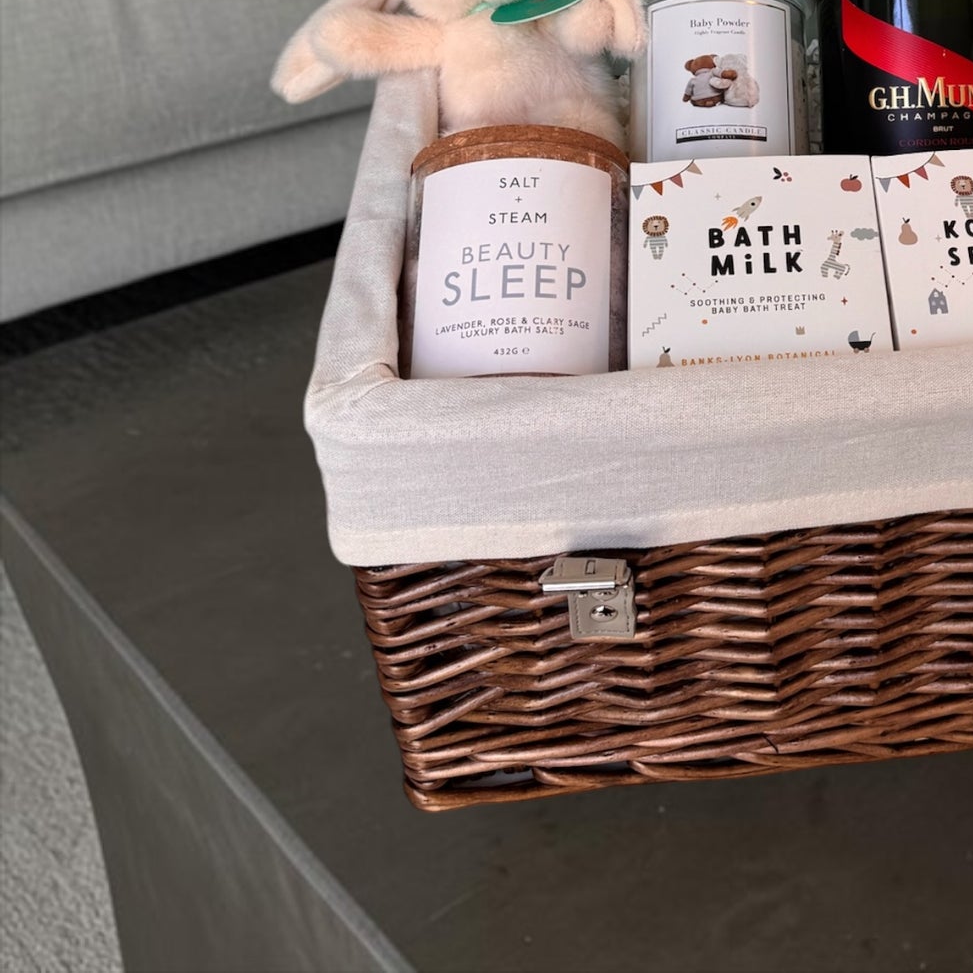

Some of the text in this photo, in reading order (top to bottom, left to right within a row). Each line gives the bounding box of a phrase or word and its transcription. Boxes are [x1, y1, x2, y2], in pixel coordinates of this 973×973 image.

[690, 18, 750, 29] Baby Powder
[682, 128, 721, 136] CLASSIC
[899, 138, 947, 147] CORDON
[499, 177, 540, 188] SALT
[488, 212, 547, 225] STEAM
[708, 225, 801, 248] BATH
[462, 242, 571, 265] BEAUTY
[442, 264, 587, 307] SLEEP
[690, 297, 745, 307] SOOTHING
[760, 293, 826, 303] PROTECTING
[711, 302, 806, 314] BABY BATH TREAT
[435, 317, 590, 335] LAVENDER, ROSE & CLARY SAGE
[461, 328, 499, 339] LUXURY
[504, 326, 531, 334] BATH
[494, 347, 518, 355] 432G
